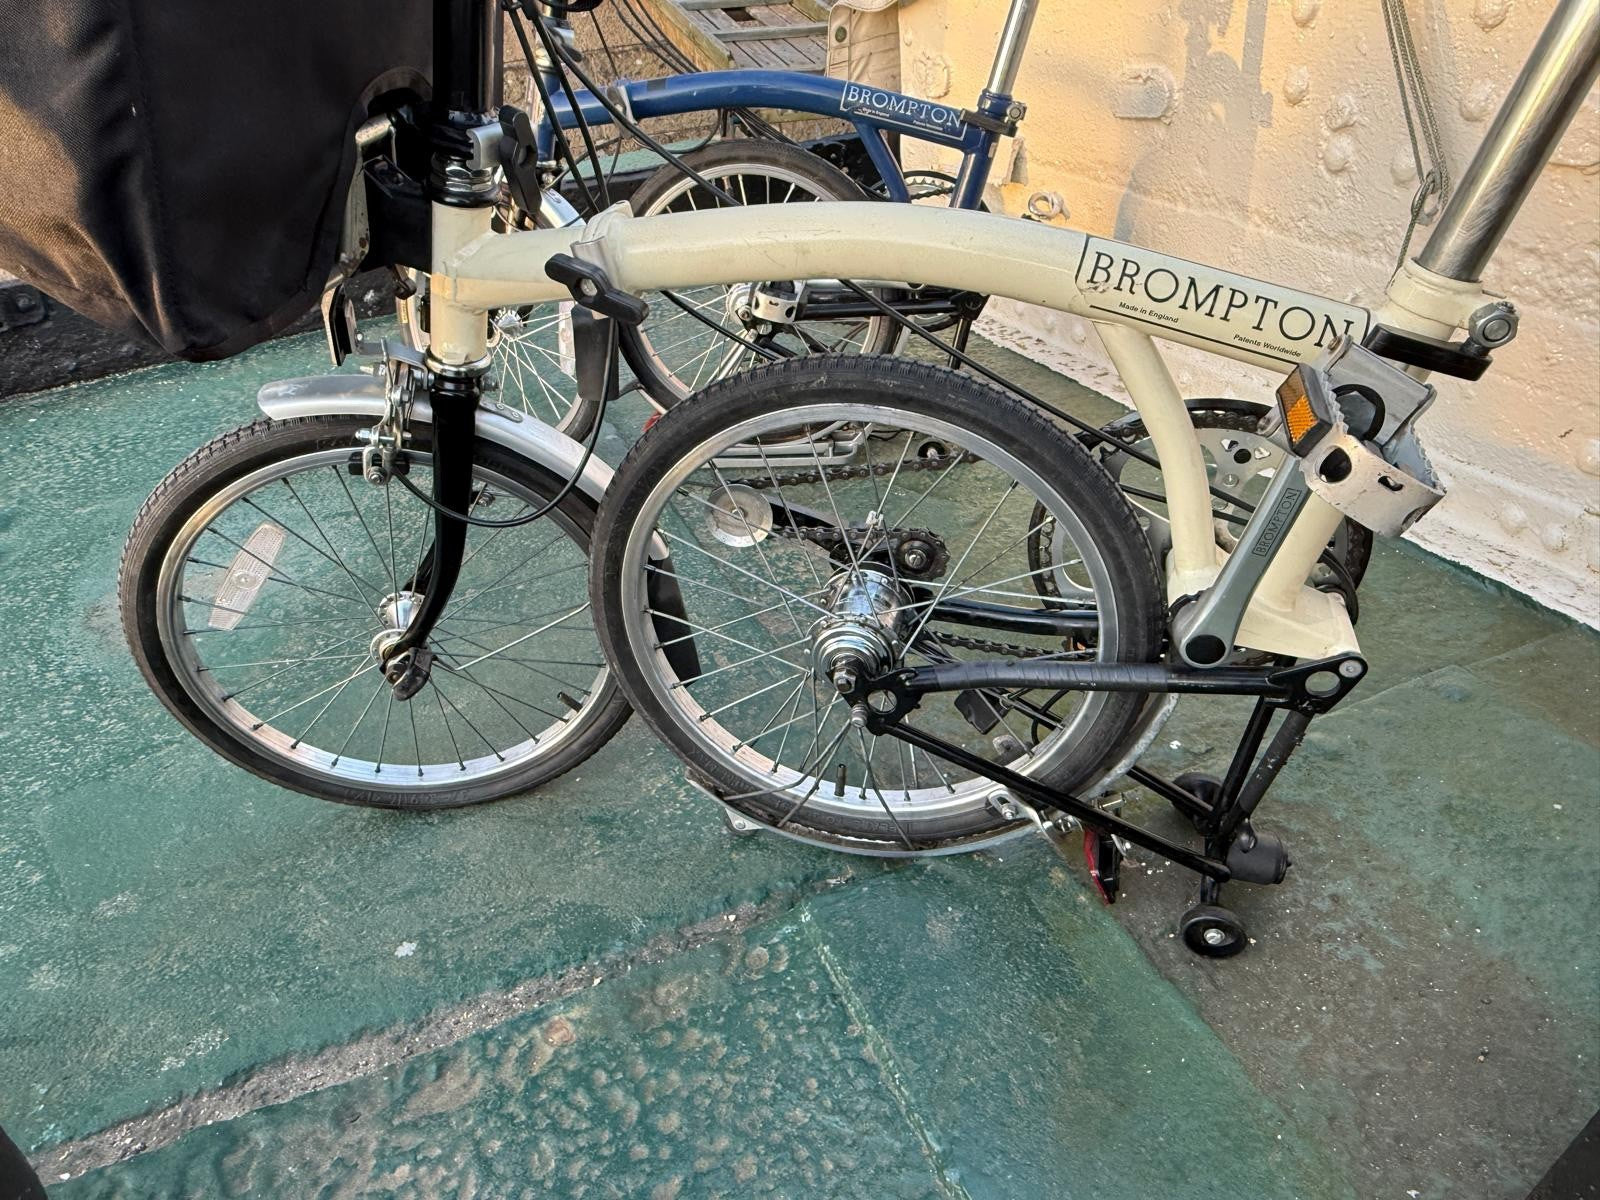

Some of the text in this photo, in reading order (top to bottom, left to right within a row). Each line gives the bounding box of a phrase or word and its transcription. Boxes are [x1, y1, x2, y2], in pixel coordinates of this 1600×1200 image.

[847, 85, 961, 128] BROMPTON
[1086, 251, 1355, 348] BROMPTON
[1118, 301, 1179, 324] Made in England
[1233, 333, 1302, 358] Patents Worldwide
[1255, 491, 1299, 554] BROMPTON
